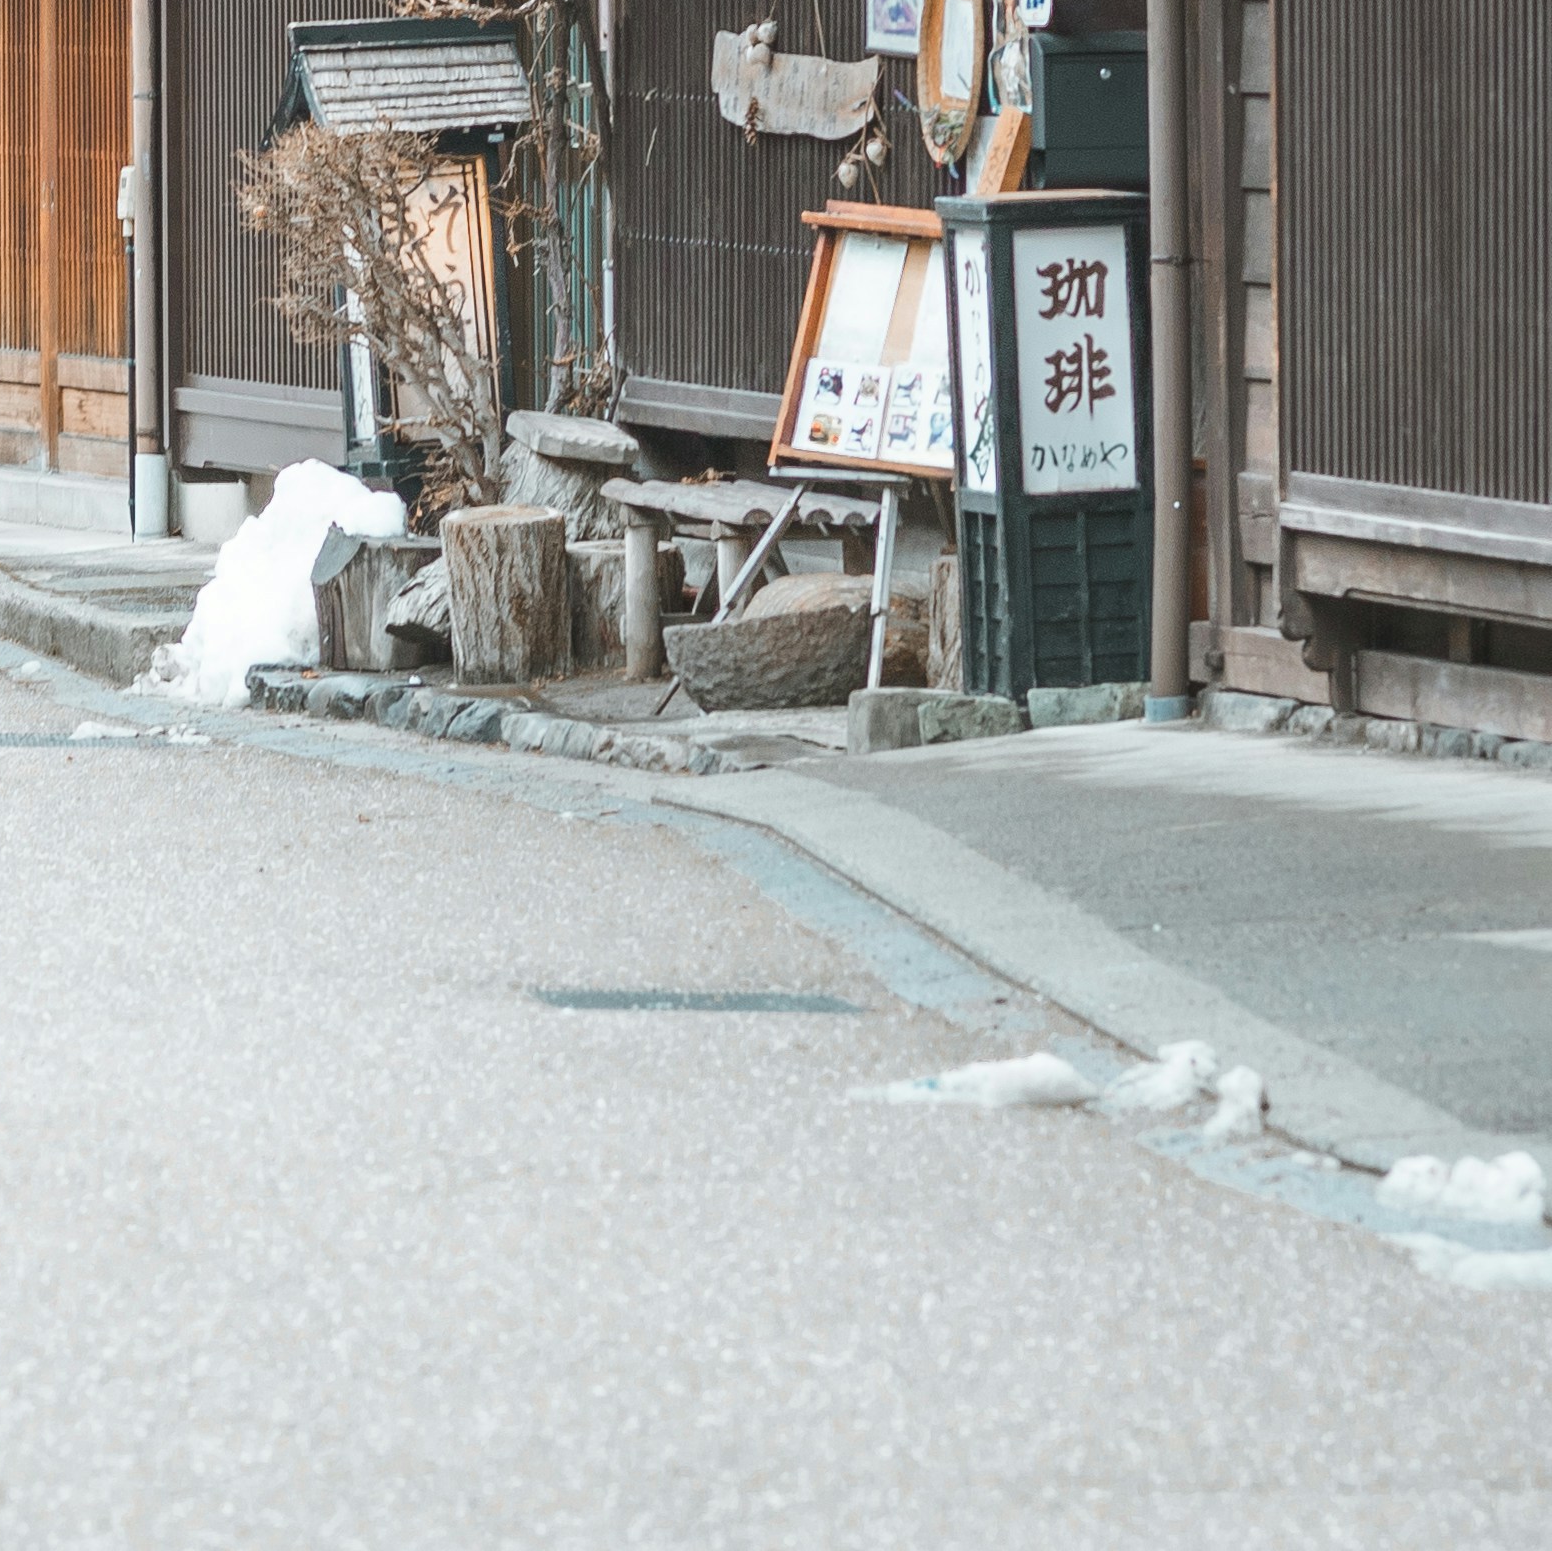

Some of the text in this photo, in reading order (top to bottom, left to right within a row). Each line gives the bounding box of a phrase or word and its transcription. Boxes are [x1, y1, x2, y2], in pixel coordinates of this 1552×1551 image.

[1036, 258, 1117, 421] 珈琲
[1030, 440, 1128, 474] かなめや
